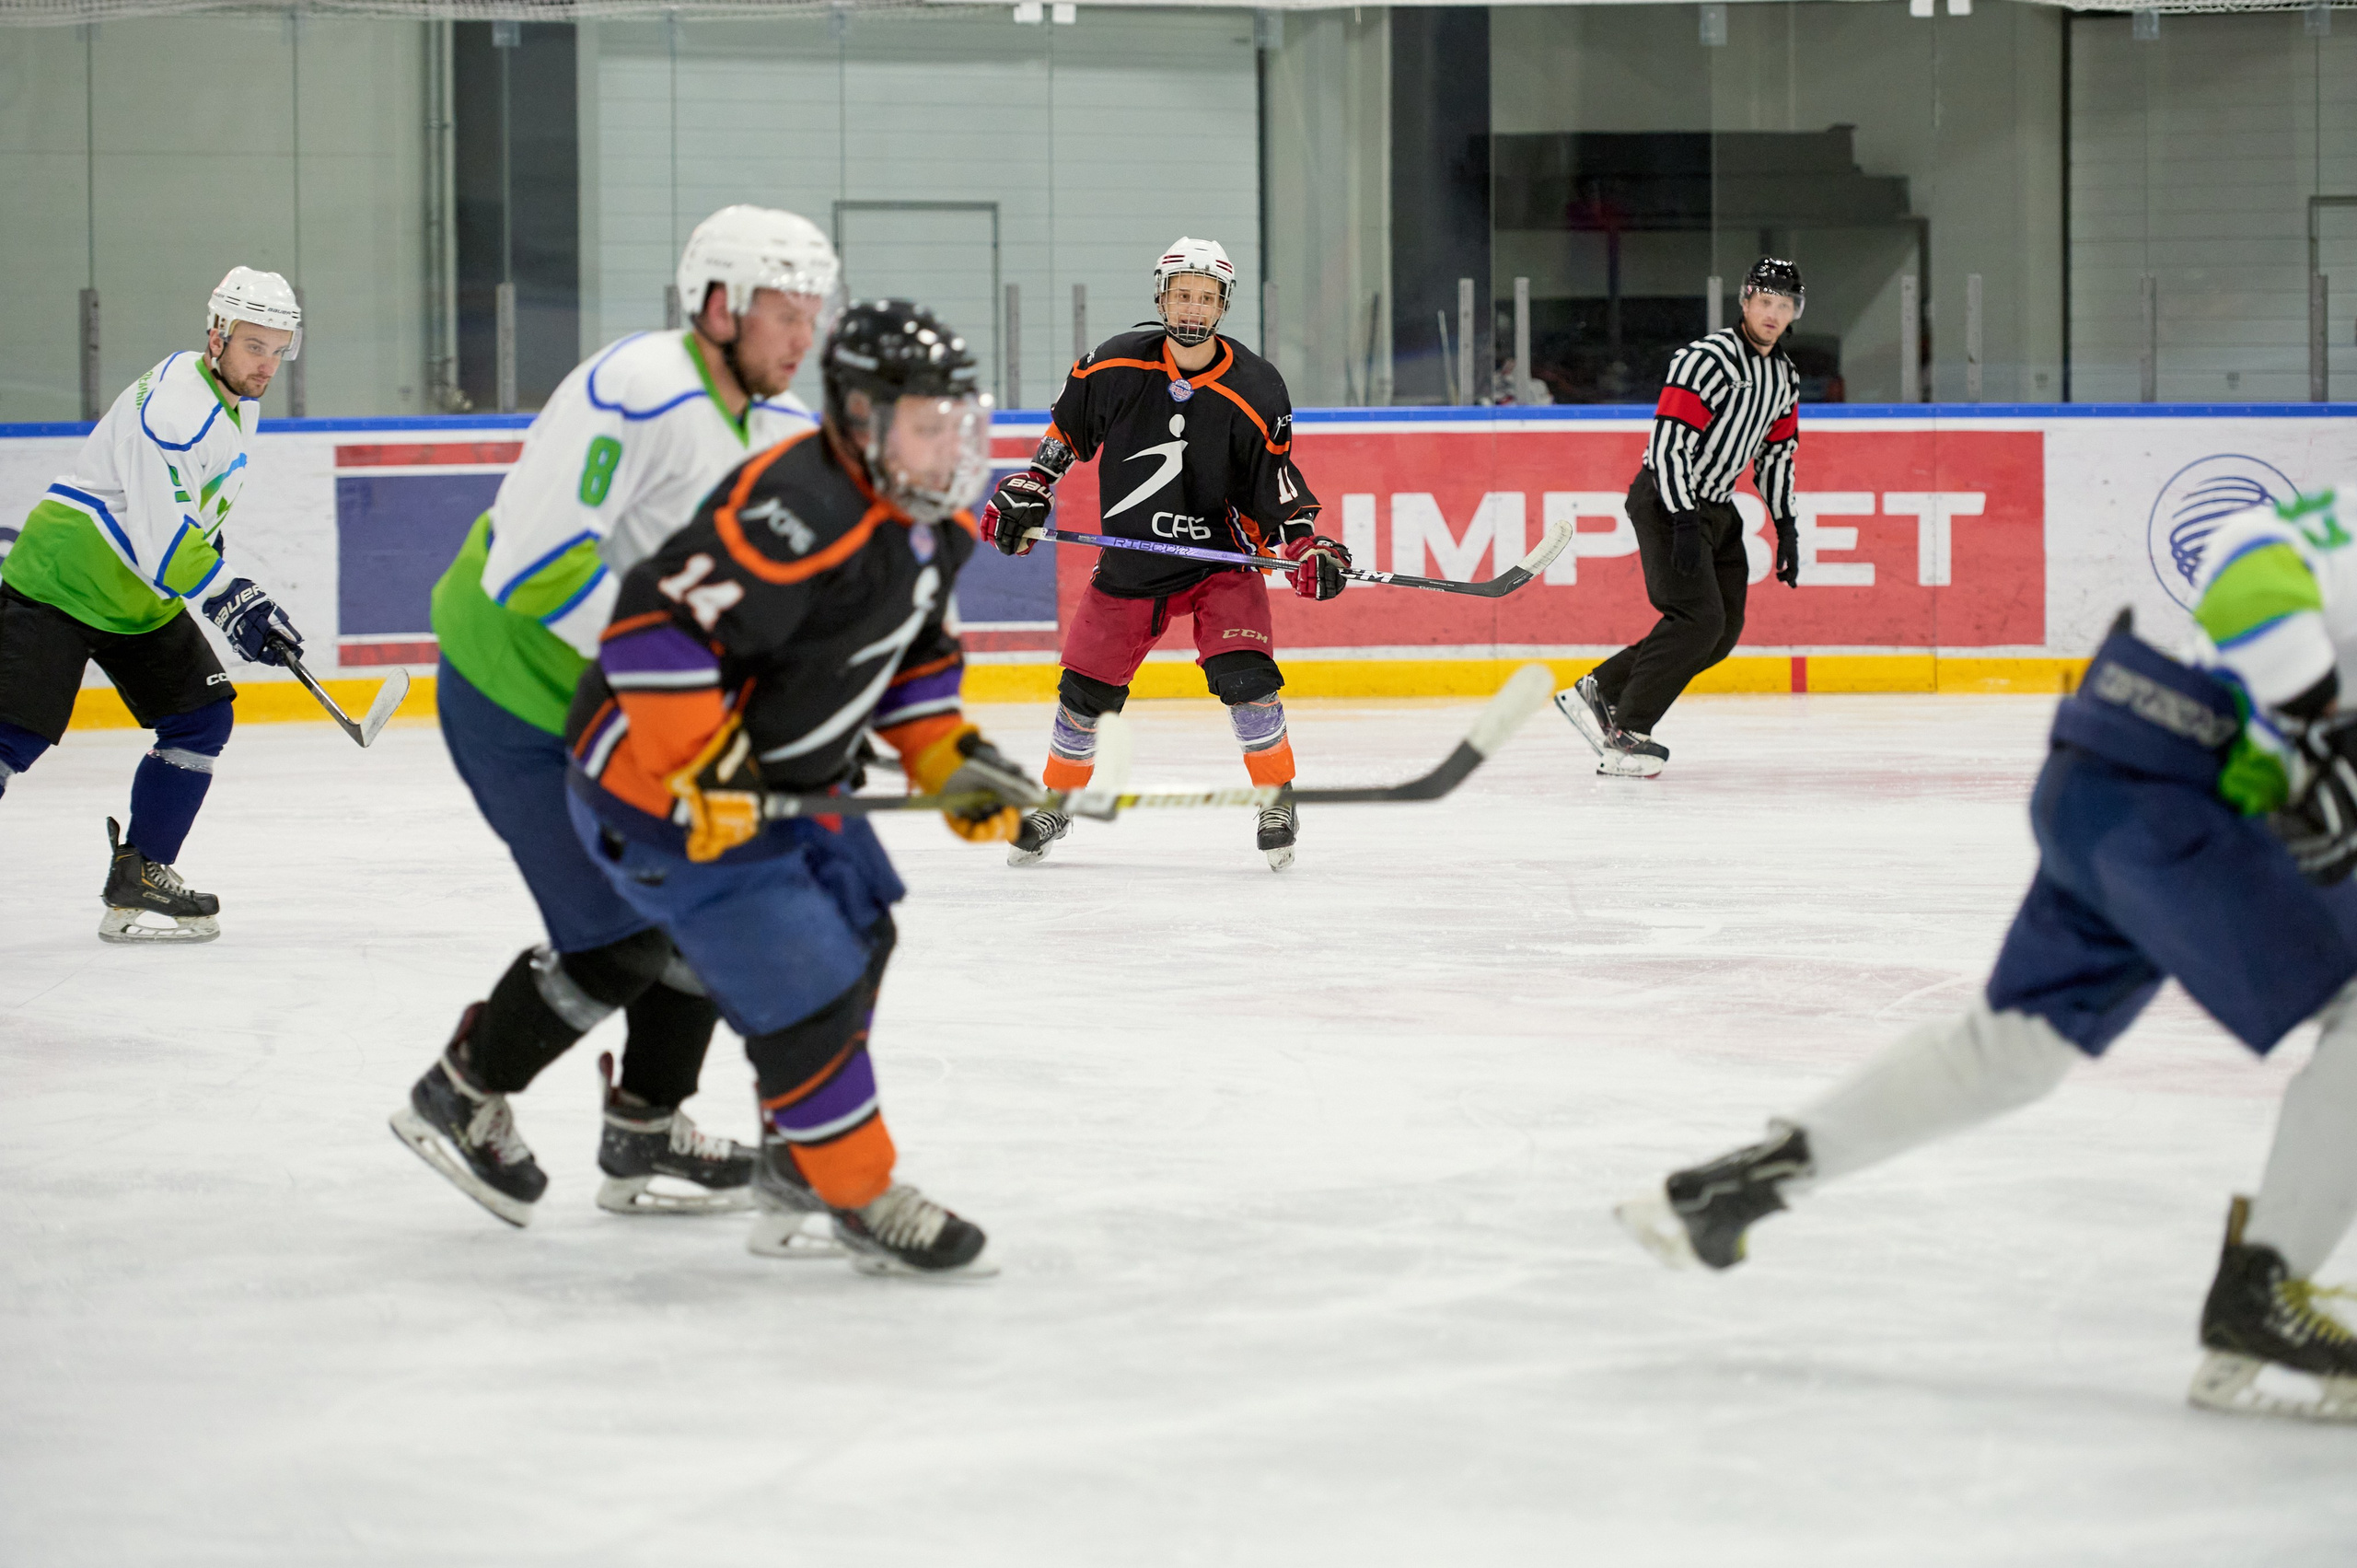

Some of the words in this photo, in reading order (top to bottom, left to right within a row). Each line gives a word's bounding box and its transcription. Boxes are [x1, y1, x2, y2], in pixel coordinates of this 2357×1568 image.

[579, 435, 622, 508] 8
[1007, 478, 1056, 512] BAU
[657, 553, 745, 633] 14
[1222, 629, 1268, 644] CCM
[206, 672, 229, 686] CC
